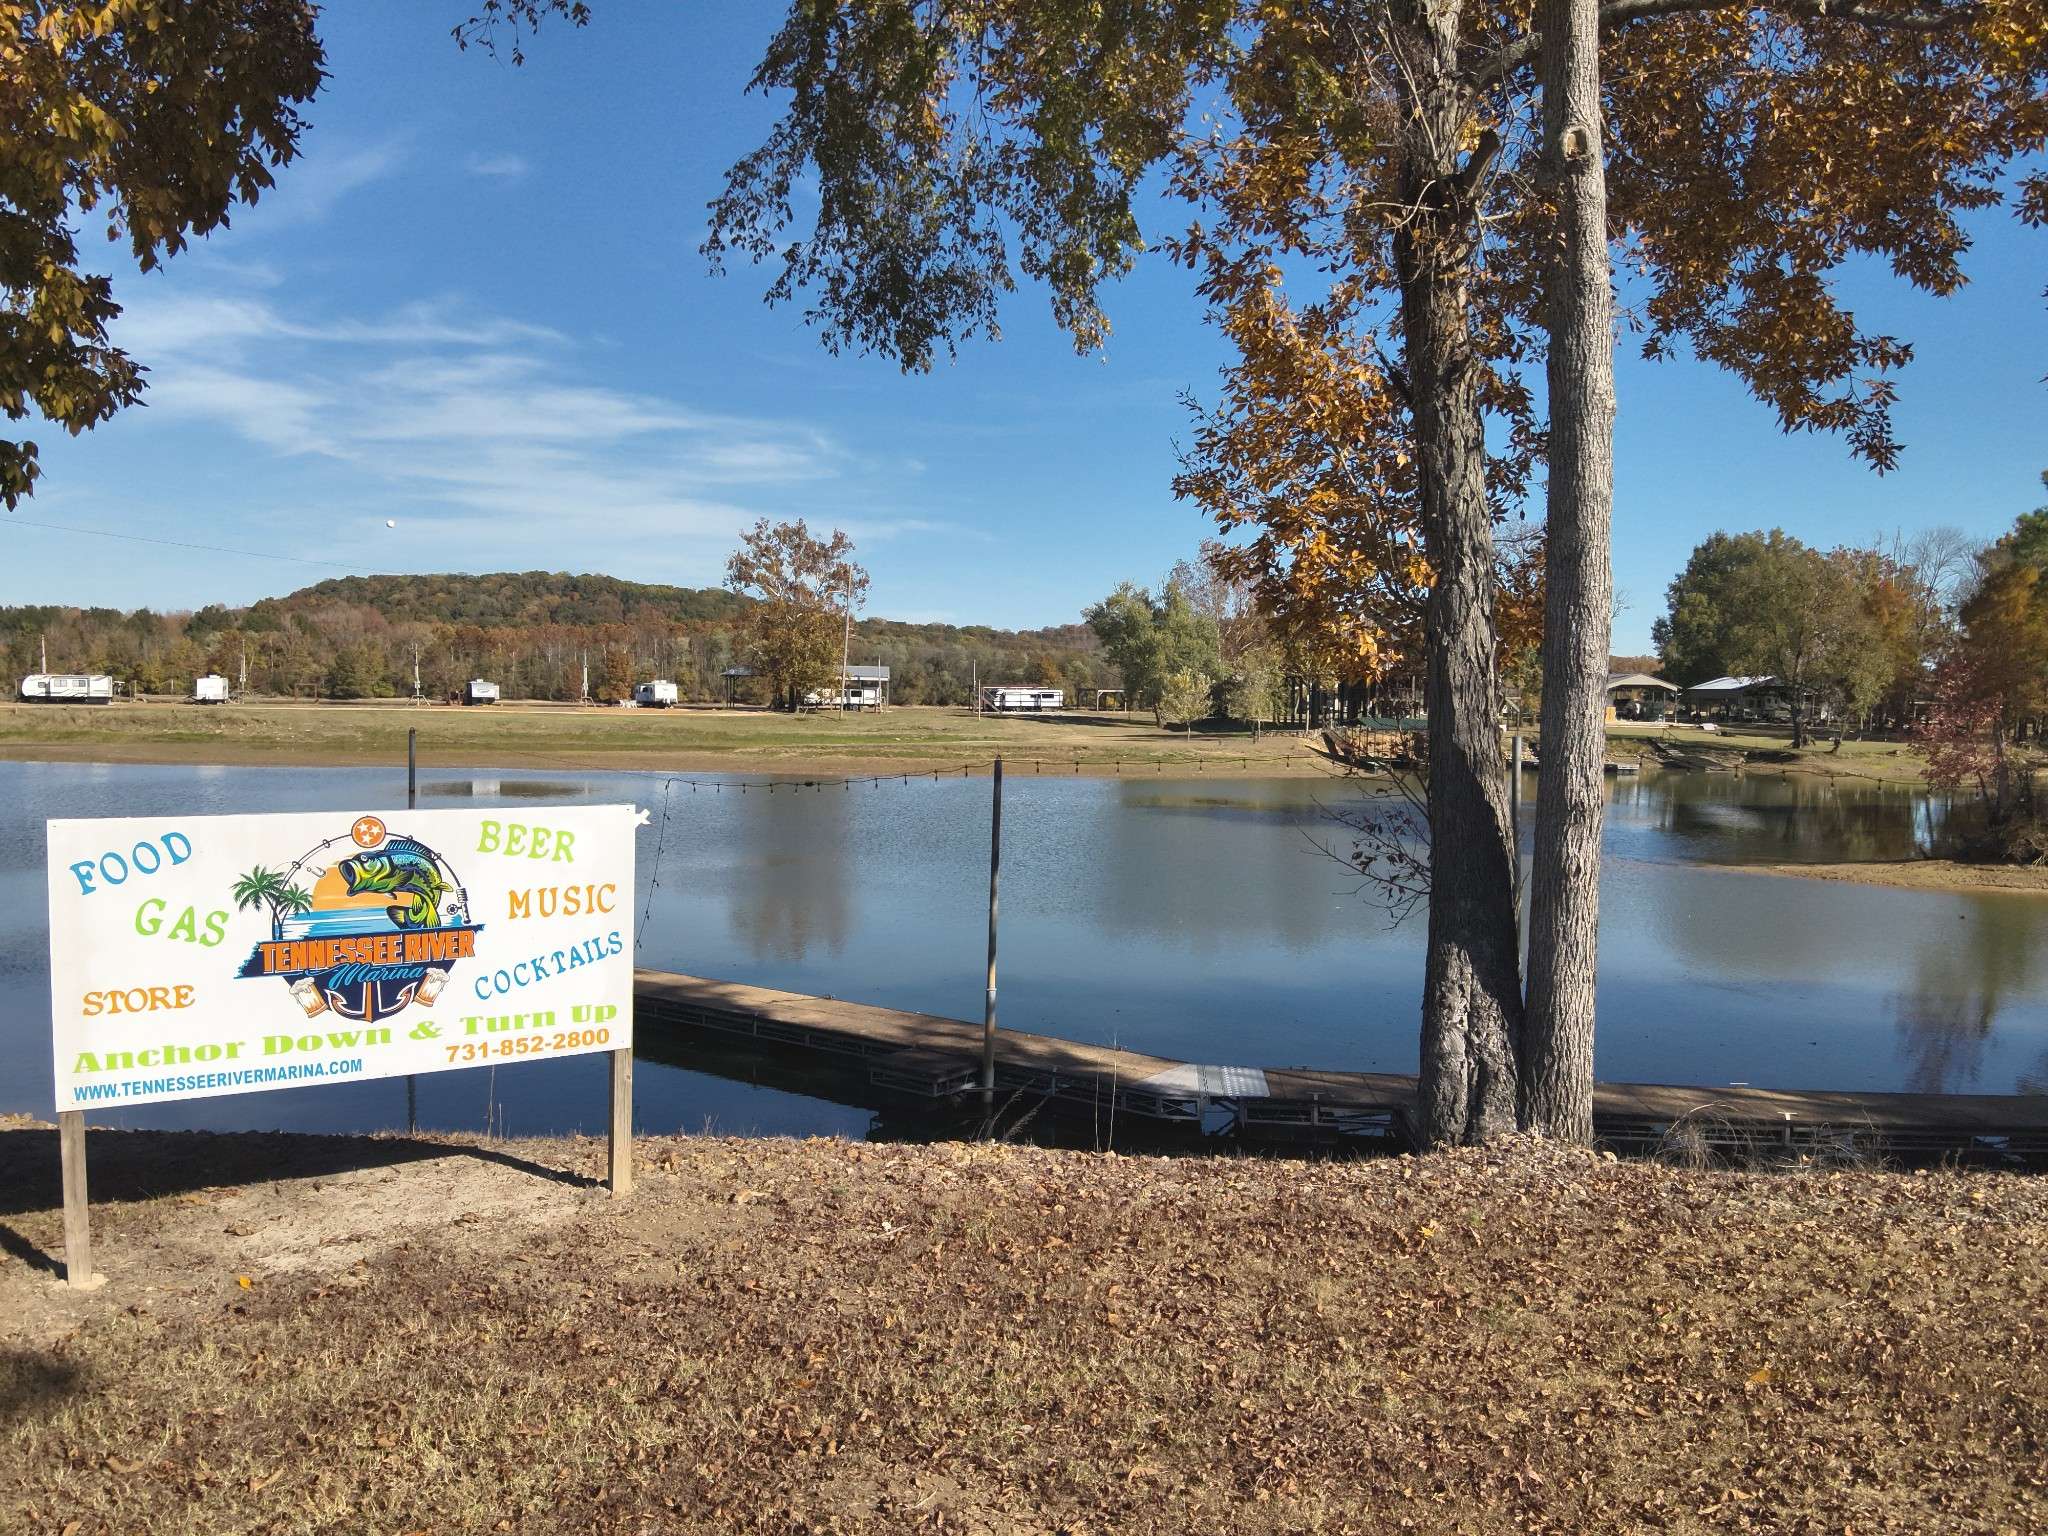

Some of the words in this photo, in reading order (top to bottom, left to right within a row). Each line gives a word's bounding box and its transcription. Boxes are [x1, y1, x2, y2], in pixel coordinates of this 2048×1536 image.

[477, 820, 575, 863] BEER
[69, 832, 191, 895] FOOD
[135, 898, 230, 947] GAS
[508, 884, 616, 919] MUSIC
[260, 936, 402, 973] TENNESSEE
[404, 931, 475, 963] RIVER
[475, 931, 623, 1000] COCKTAILS
[328, 962, 424, 990] Marina
[82, 985, 195, 1016] STORE
[72, 1041, 246, 1073] Anchor
[261, 1028, 392, 1055] Down
[409, 1021, 443, 1040] &
[459, 1011, 556, 1035] Turn
[446, 1028, 610, 1063] 731-852-2800
[73, 1058, 363, 1101] WWW.TENNESSEERIVERMARINA.COM
